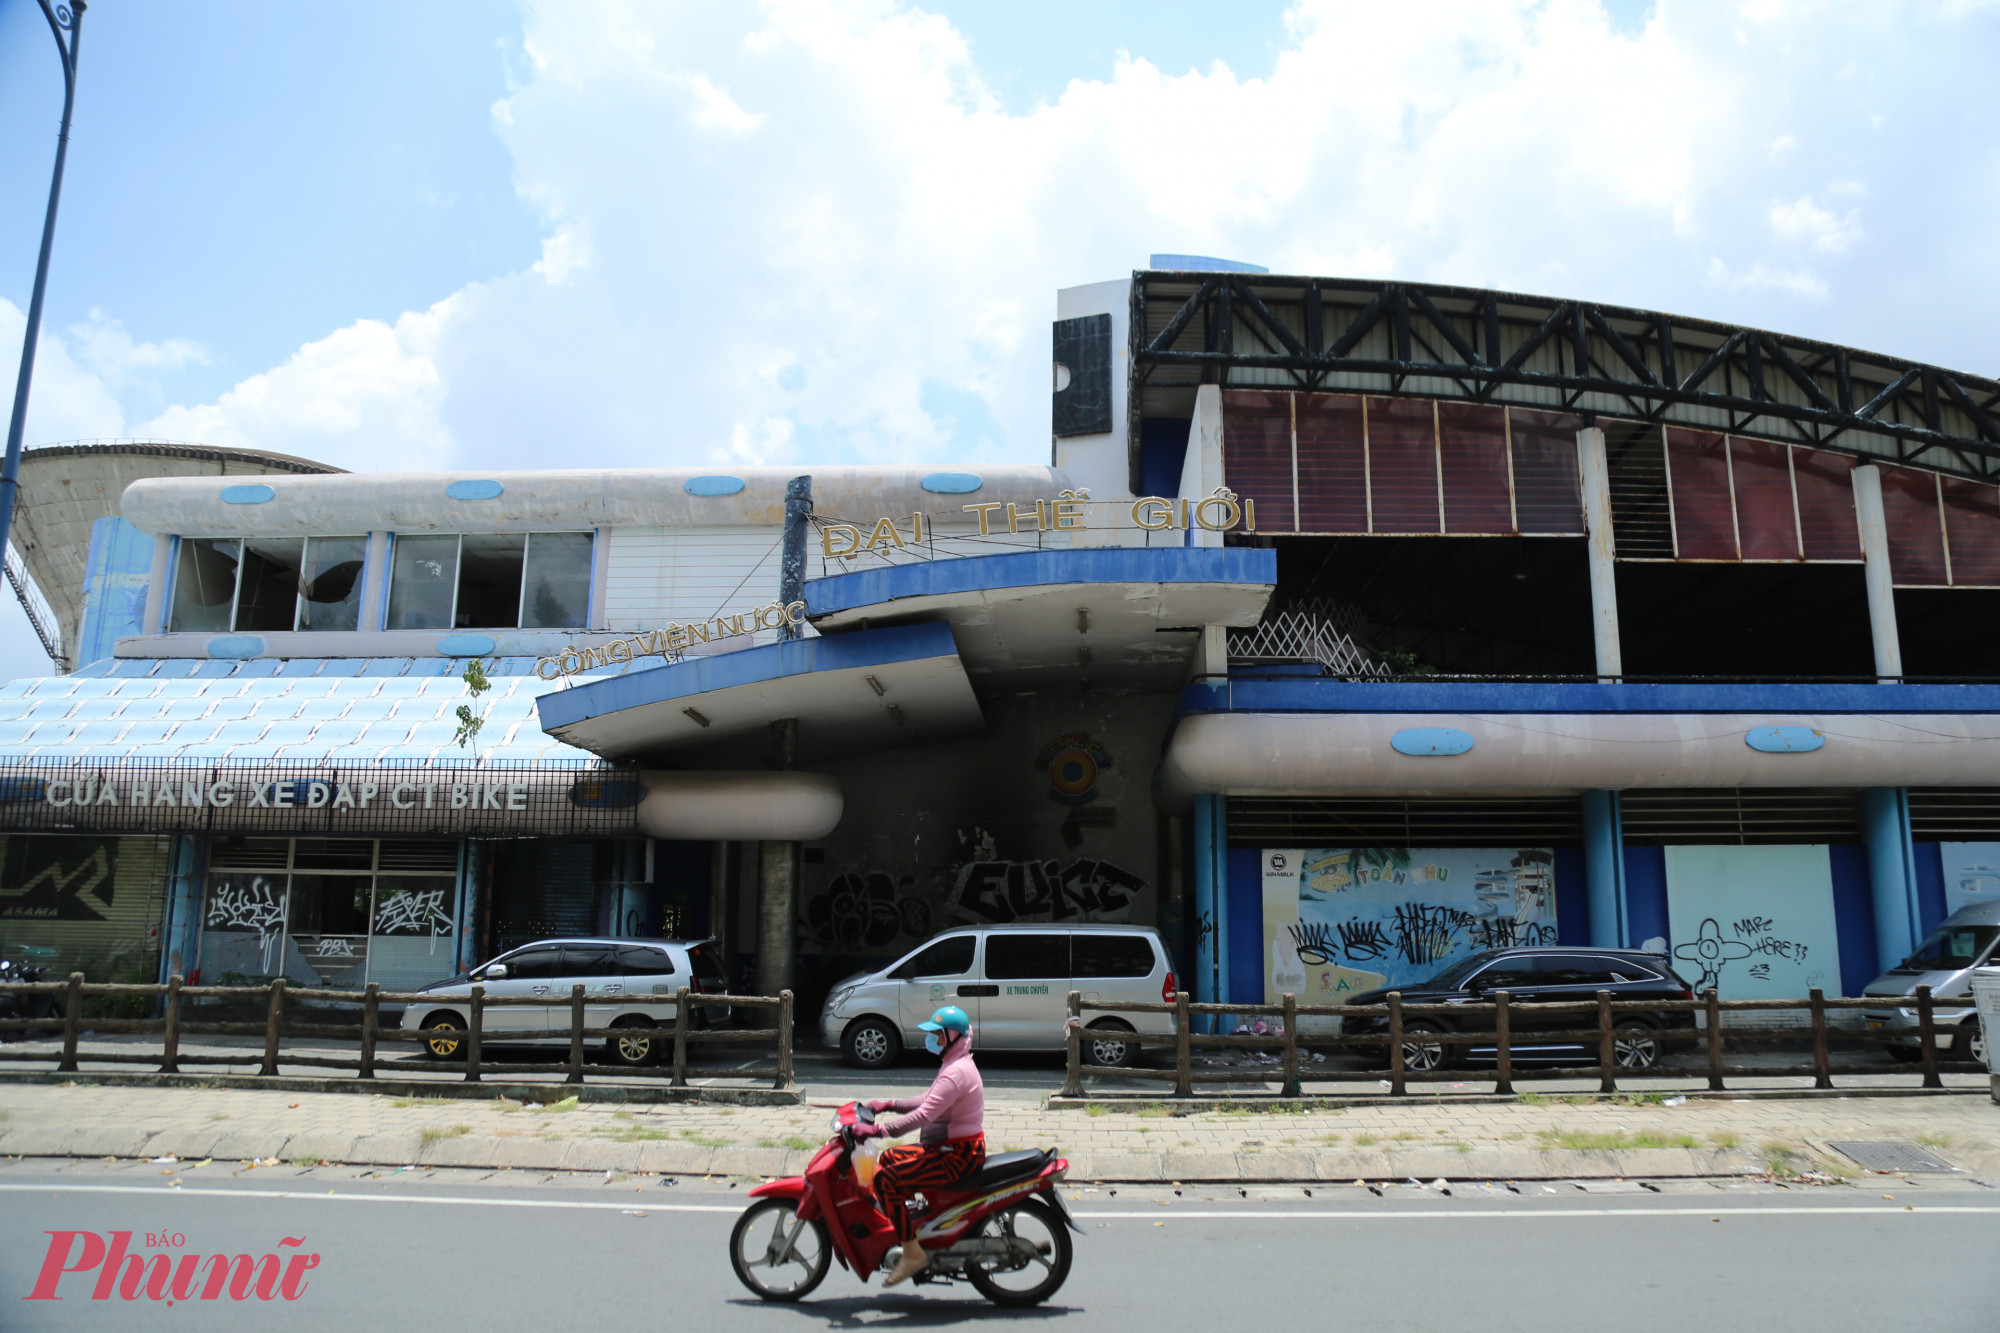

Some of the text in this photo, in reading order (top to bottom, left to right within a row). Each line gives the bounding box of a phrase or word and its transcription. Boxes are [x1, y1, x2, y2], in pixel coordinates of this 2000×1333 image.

[963, 487, 1091, 537] THẾ
[1130, 486, 1256, 531] GIỚI
[537, 600, 807, 681] CÔNG VIÊN NƯỚC
[46, 771, 528, 813] CỬA HÀNG XE ĐẠP CT BIKE
[2, 906, 59, 917] ASAMA
